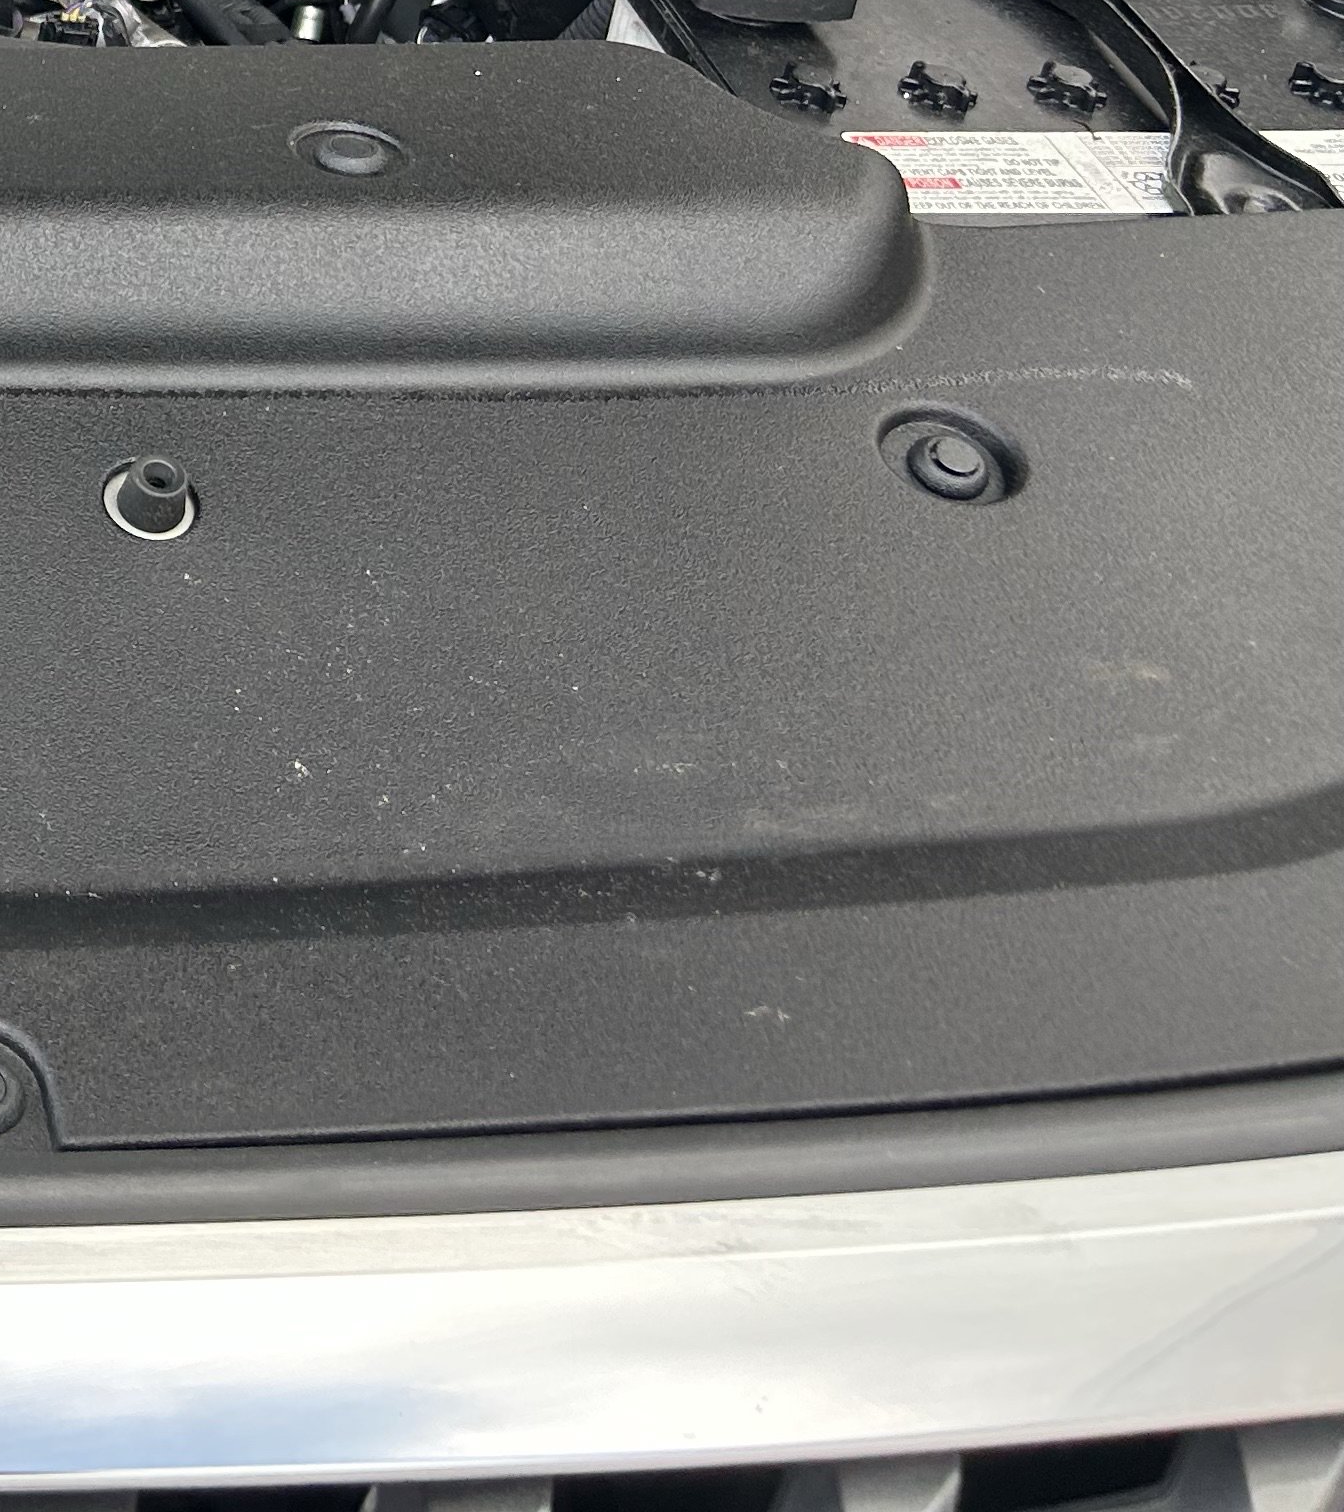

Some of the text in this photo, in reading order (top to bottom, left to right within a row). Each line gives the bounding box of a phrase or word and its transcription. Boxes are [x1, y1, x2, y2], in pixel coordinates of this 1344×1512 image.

[1003, 158, 1020, 166] DO
[1020, 158, 1043, 166] NOT
[1001, 177, 1046, 188] SEVERE
[934, 201, 956, 209] OUT
[957, 201, 973, 209] OF
[974, 201, 995, 209] THE
[996, 201, 1034, 209] REACH
[1035, 201, 1050, 209] OF
[1051, 201, 1106, 209] CHILDREN
